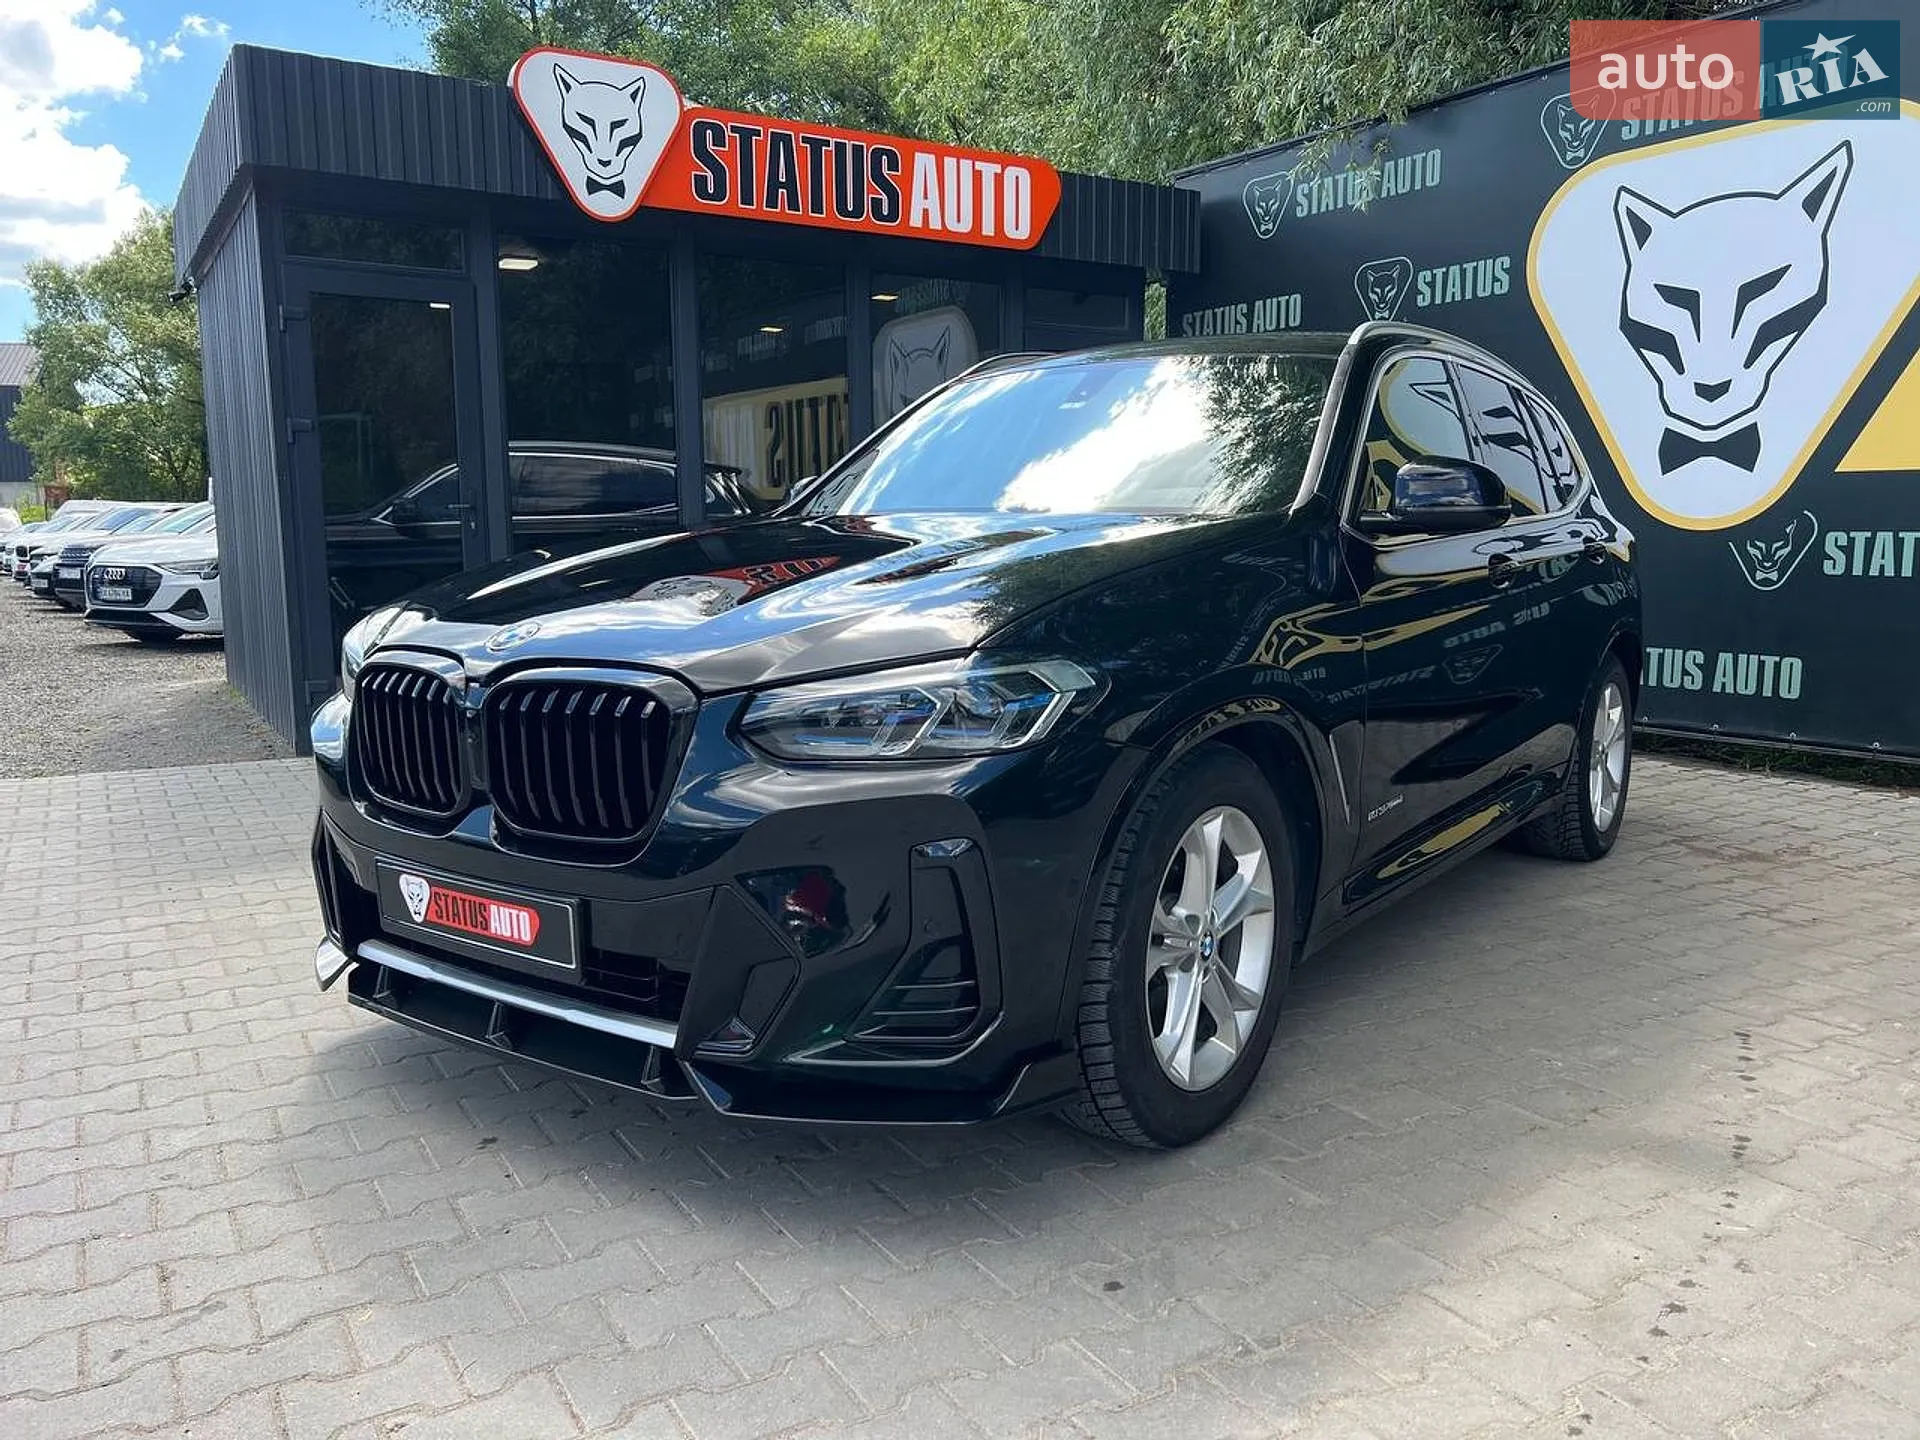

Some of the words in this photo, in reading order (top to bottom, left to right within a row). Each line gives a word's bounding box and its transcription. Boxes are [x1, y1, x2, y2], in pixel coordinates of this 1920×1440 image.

[689, 118, 902, 226] STATUS
[909, 152, 1031, 240] AUTO
[1381, 149, 1441, 198] AUTO
[1416, 255, 1511, 308] STATUS
[1182, 303, 1248, 338] STATUS
[1252, 293, 1302, 333] AUTO
[1823, 531, 1920, 577] STAT
[1640, 647, 1704, 691] TUS
[1712, 652, 1803, 700] AUTO
[433, 891, 489, 931] STATUS
[489, 904, 532, 942] AUTO
